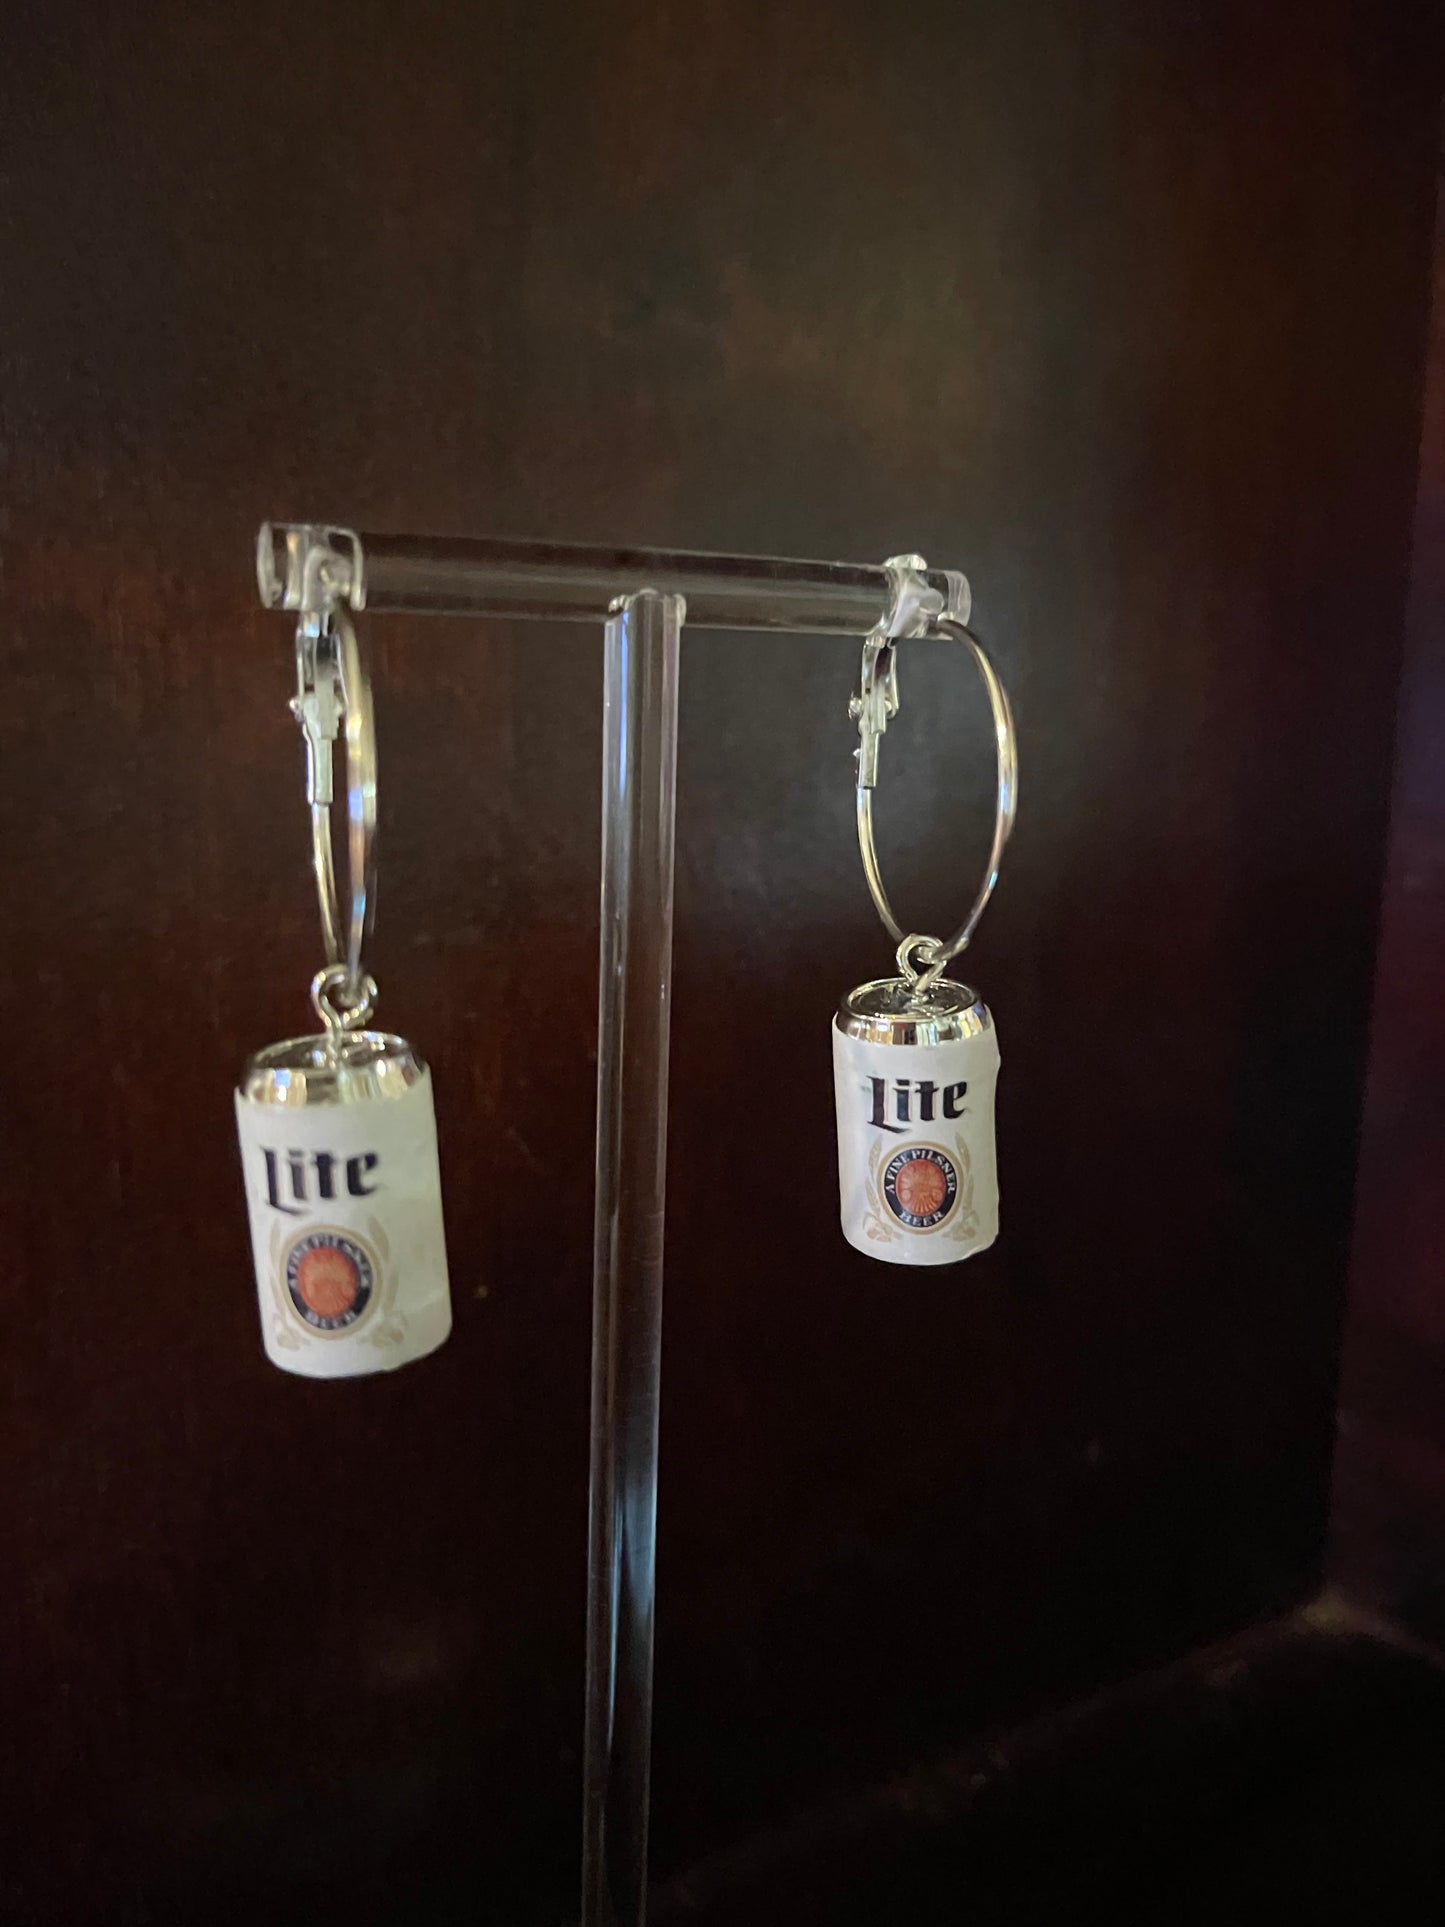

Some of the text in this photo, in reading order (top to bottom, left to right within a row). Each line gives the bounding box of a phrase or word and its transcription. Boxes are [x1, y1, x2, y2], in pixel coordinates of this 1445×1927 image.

[867, 1075, 967, 1133] Lite
[261, 1145, 380, 1215] Lite
[886, 1155, 910, 1180] FINE
[912, 1149, 956, 1194] PILSNER
[899, 1211, 944, 1227] BEER
